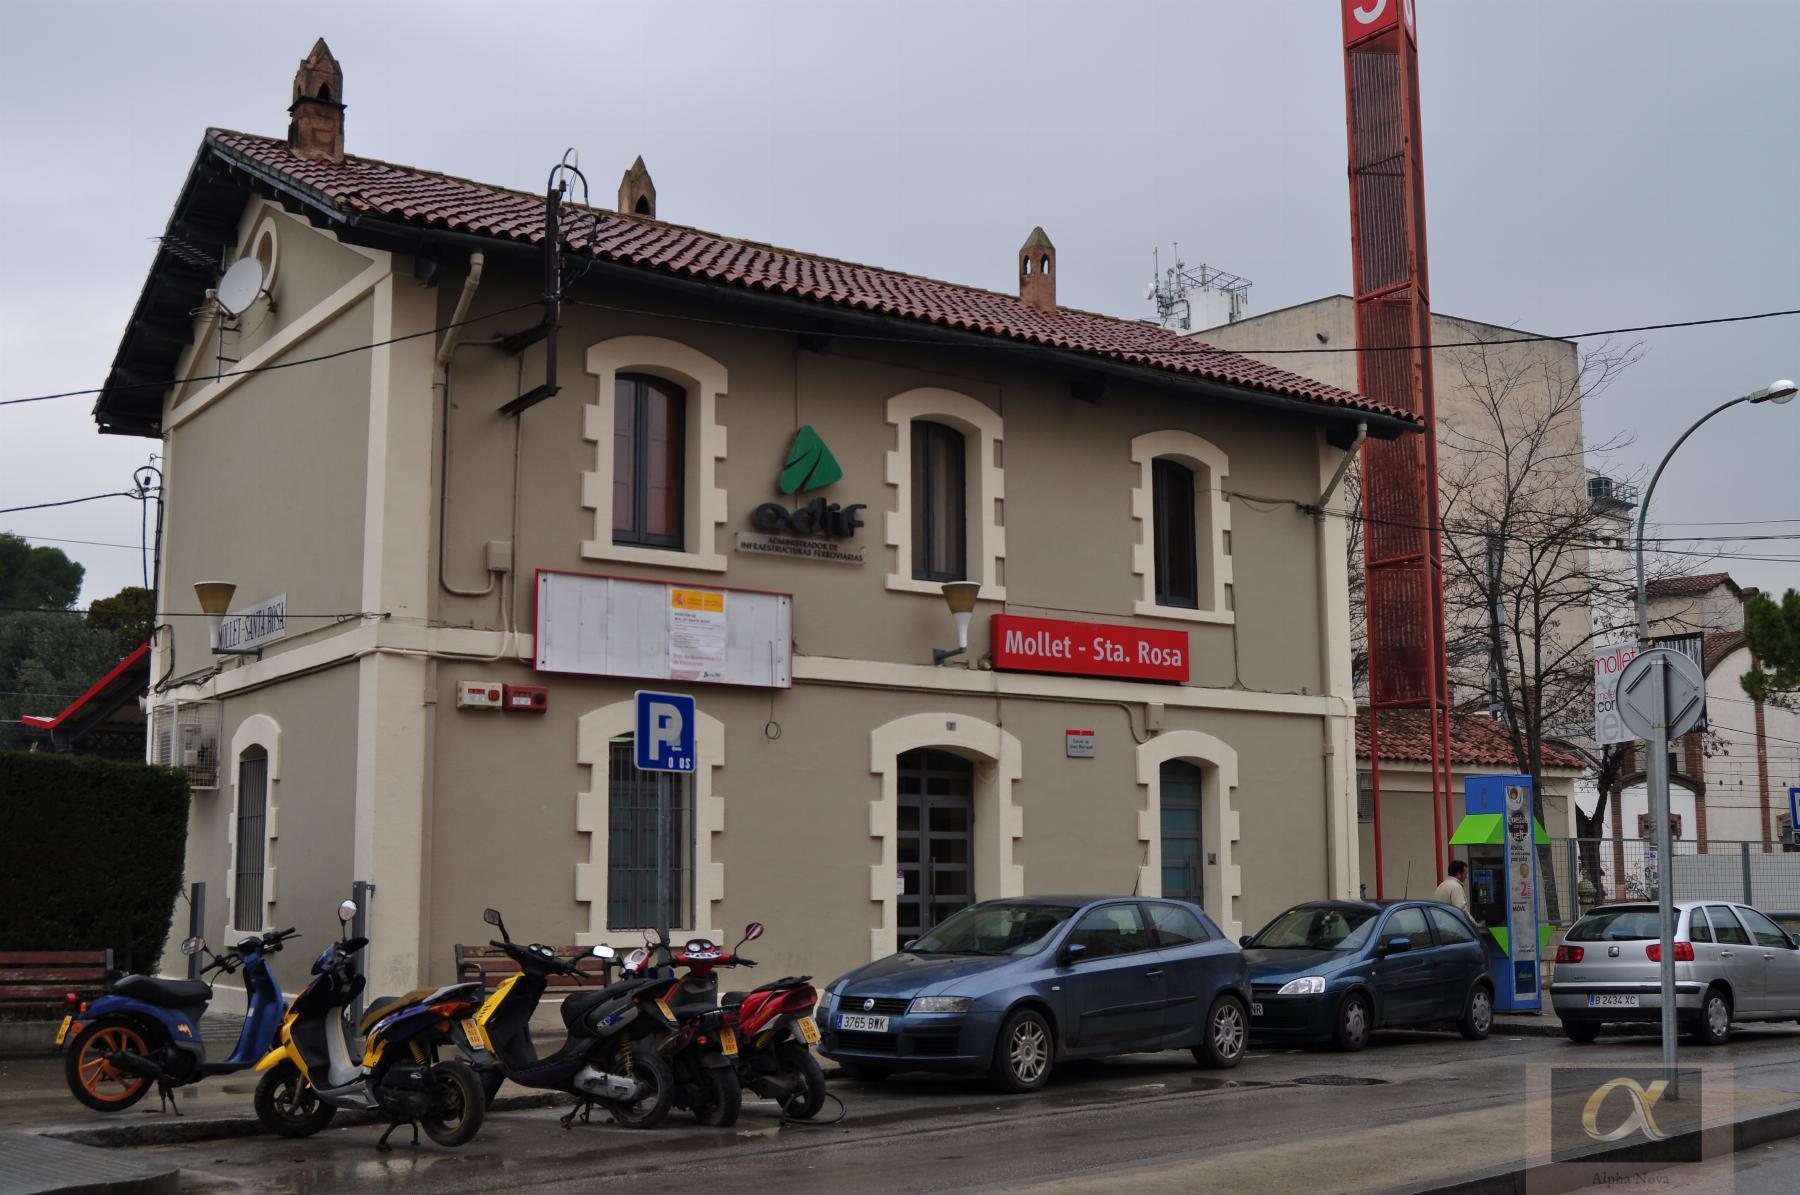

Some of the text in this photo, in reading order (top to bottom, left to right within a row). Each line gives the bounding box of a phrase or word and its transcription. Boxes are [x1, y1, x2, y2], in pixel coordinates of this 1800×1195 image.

[741, 541, 863, 561] INFRAESTRUCTURAS FERROVIARIAS
[768, 537, 838, 551] ADMINISTRADOR DE
[1005, 630, 1071, 658] Mollet
[1093, 637, 1131, 663] Sta.
[1138, 641, 1182, 667] Rosa
[649, 702, 682, 760] P
[1520, 881, 1528, 897] 2
[1595, 996, 1636, 1005] B 2434 XC
[844, 1016, 886, 1030] 3765 BWK
